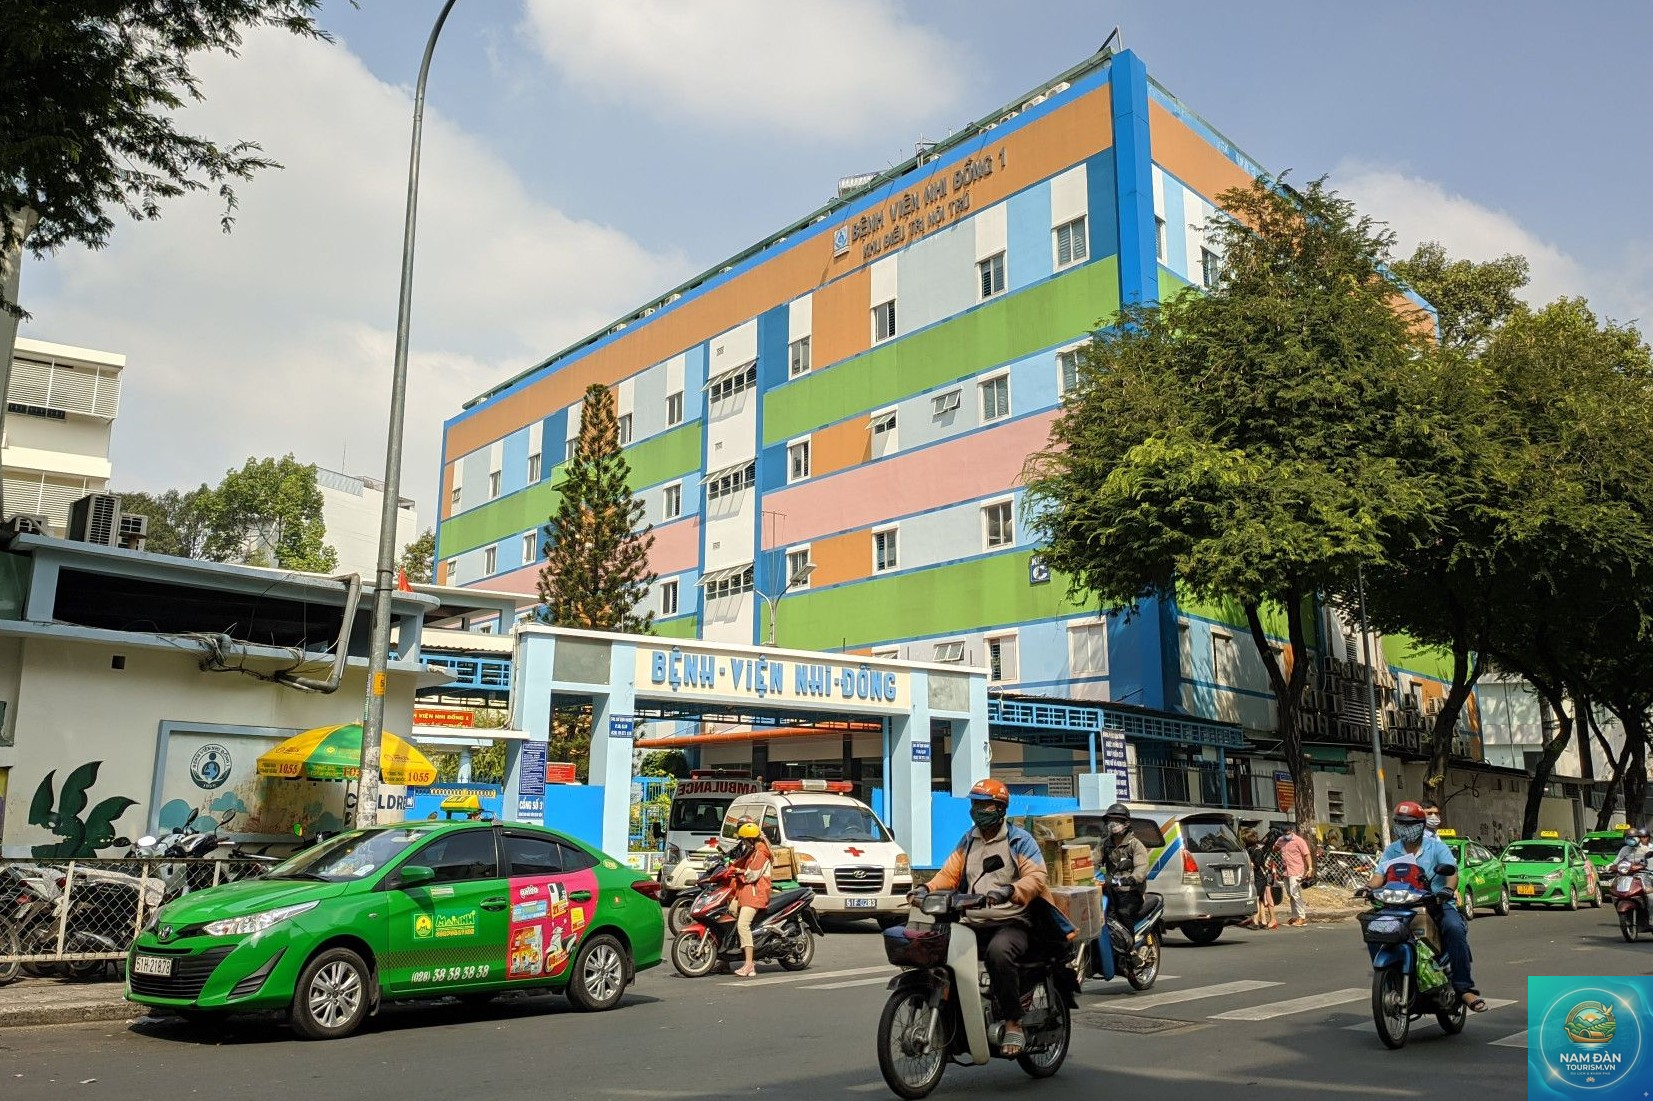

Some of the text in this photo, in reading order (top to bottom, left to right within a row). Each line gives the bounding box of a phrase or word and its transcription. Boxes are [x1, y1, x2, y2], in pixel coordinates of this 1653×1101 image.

[852, 146, 1006, 243] BỆNH VIỆN NHI ĐỒNG 1
[279, 764, 298, 775] 1055
[408, 772, 430, 783] 1055
[412, 965, 490, 983] (028) 38 38 38 38
